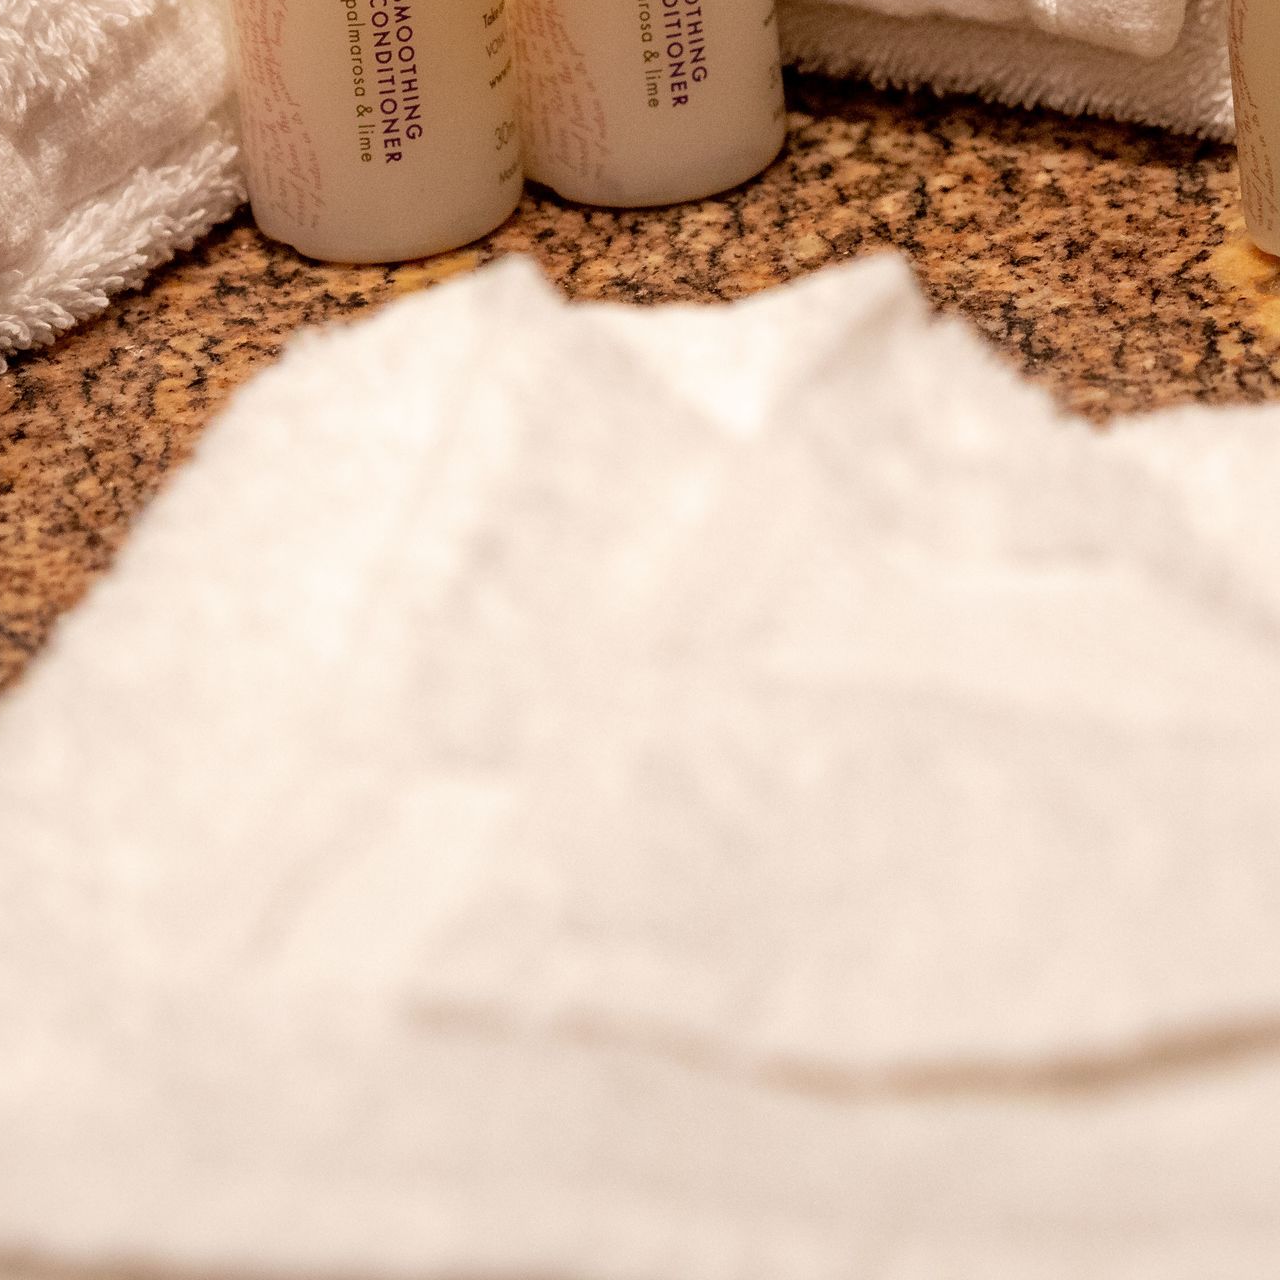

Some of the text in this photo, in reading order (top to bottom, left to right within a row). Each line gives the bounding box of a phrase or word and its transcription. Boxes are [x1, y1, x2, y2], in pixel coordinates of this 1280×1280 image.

[643, 50, 660, 63] &
[645, 70, 662, 108] lime
[356, 104, 373, 118] &
[358, 124, 376, 162] lime
